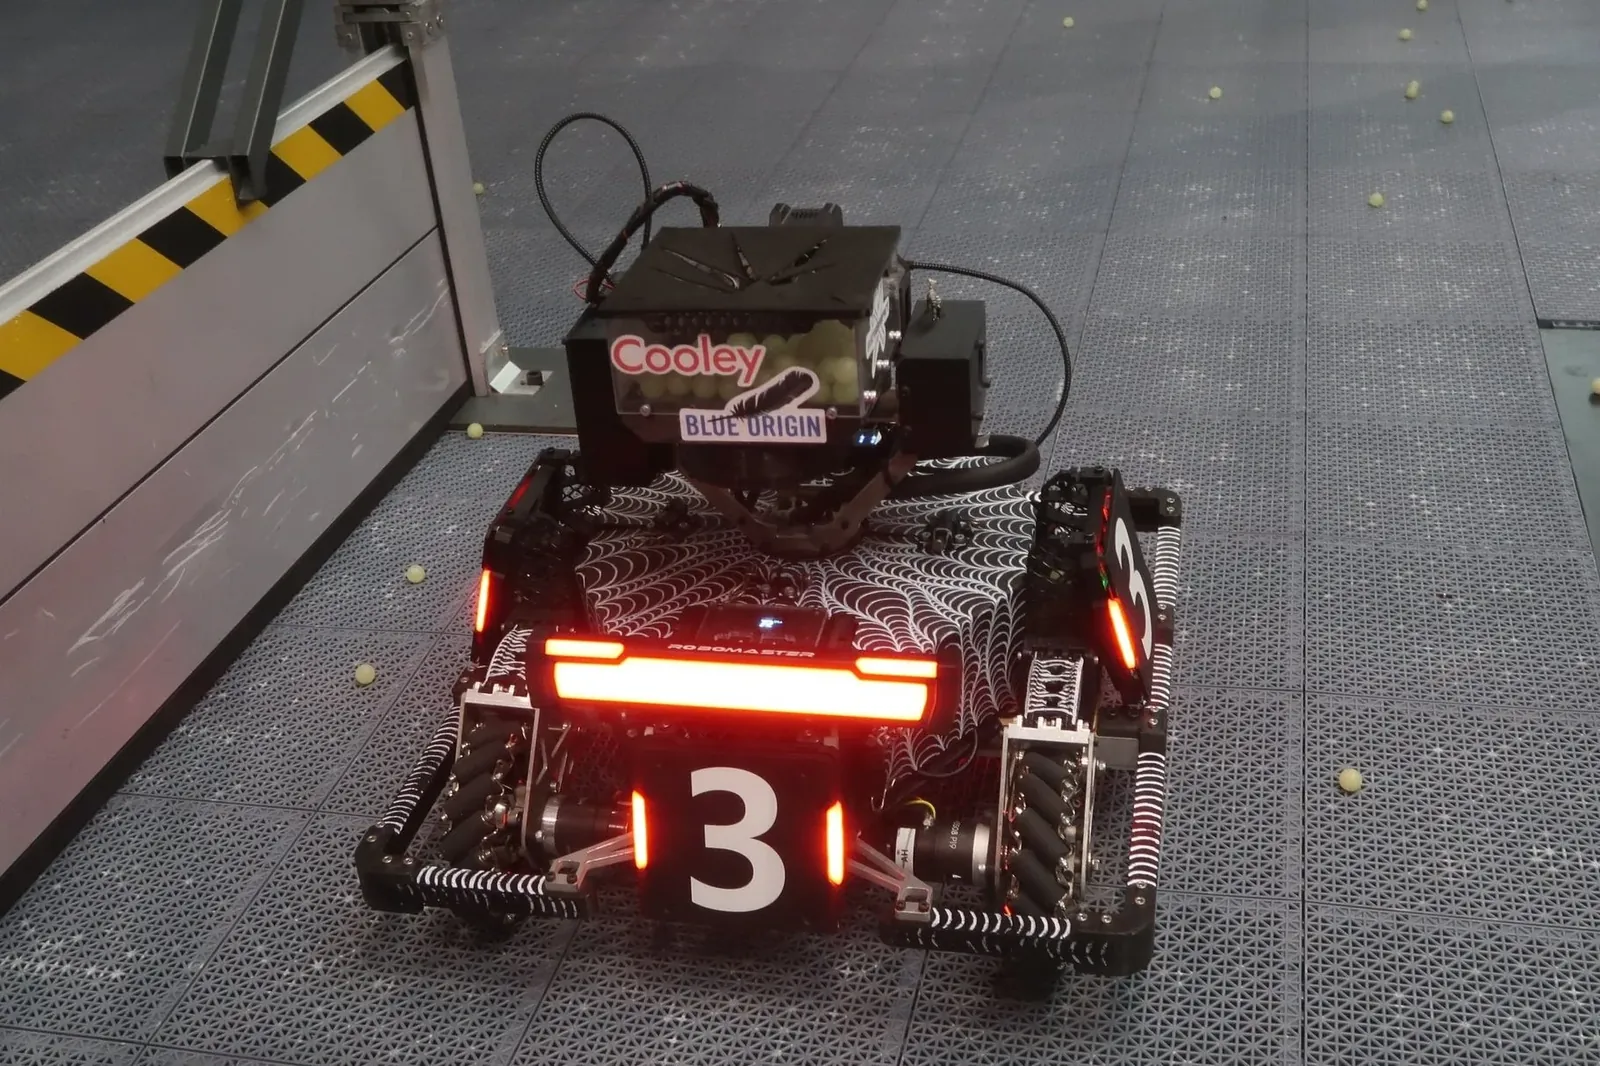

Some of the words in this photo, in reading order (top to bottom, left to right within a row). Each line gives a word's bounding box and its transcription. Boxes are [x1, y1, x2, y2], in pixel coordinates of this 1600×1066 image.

[612, 335, 763, 384] Cooley
[685, 414, 740, 437] BLUE
[747, 414, 821, 437] ORIGIN
[1115, 517, 1152, 660] 3
[667, 643, 815, 658] ROBOMASTER
[690, 766, 786, 913] 3
